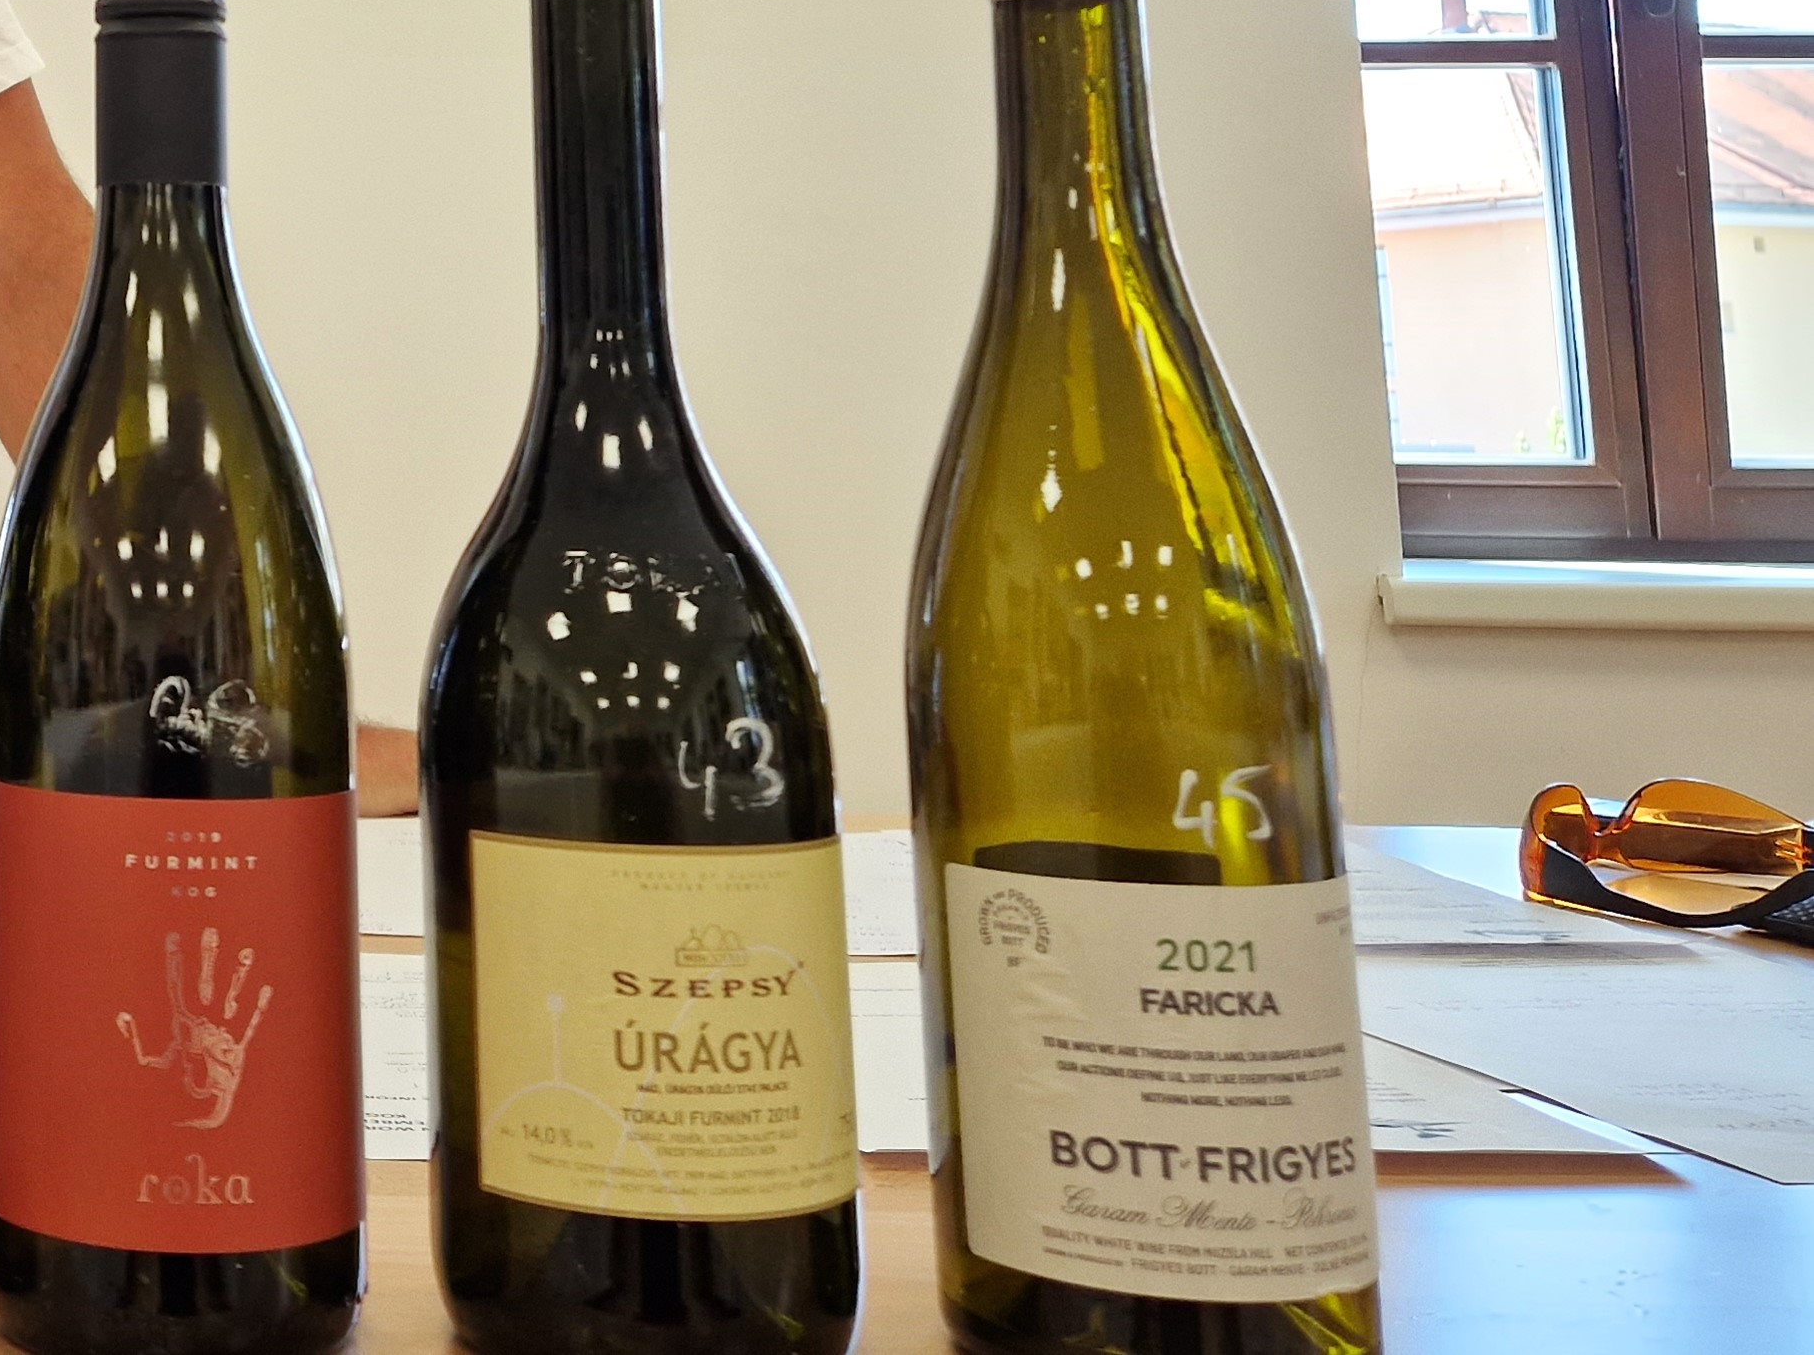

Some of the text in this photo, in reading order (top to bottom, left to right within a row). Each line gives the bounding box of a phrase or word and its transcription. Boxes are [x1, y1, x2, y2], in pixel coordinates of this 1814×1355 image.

[677, 716, 785, 822] 43
[1172, 764, 1273, 849] 45
[124, 853, 258, 871] FURMINT
[1155, 938, 1256, 973] 2021
[1139, 988, 1281, 1017] FARICKA
[614, 1018, 803, 1075] ÚRÁGYA
[621, 1106, 683, 1125] TOKAJI
[689, 1108, 762, 1126] FURMINT
[1049, 1129, 1356, 1185] BOTT FRIGYES
[136, 1152, 255, 1205] roka
[1042, 1225, 1091, 1244] QUALITY
[1094, 1236, 1132, 1251] WHITE
[1186, 1262, 1217, 1276] BOTT
